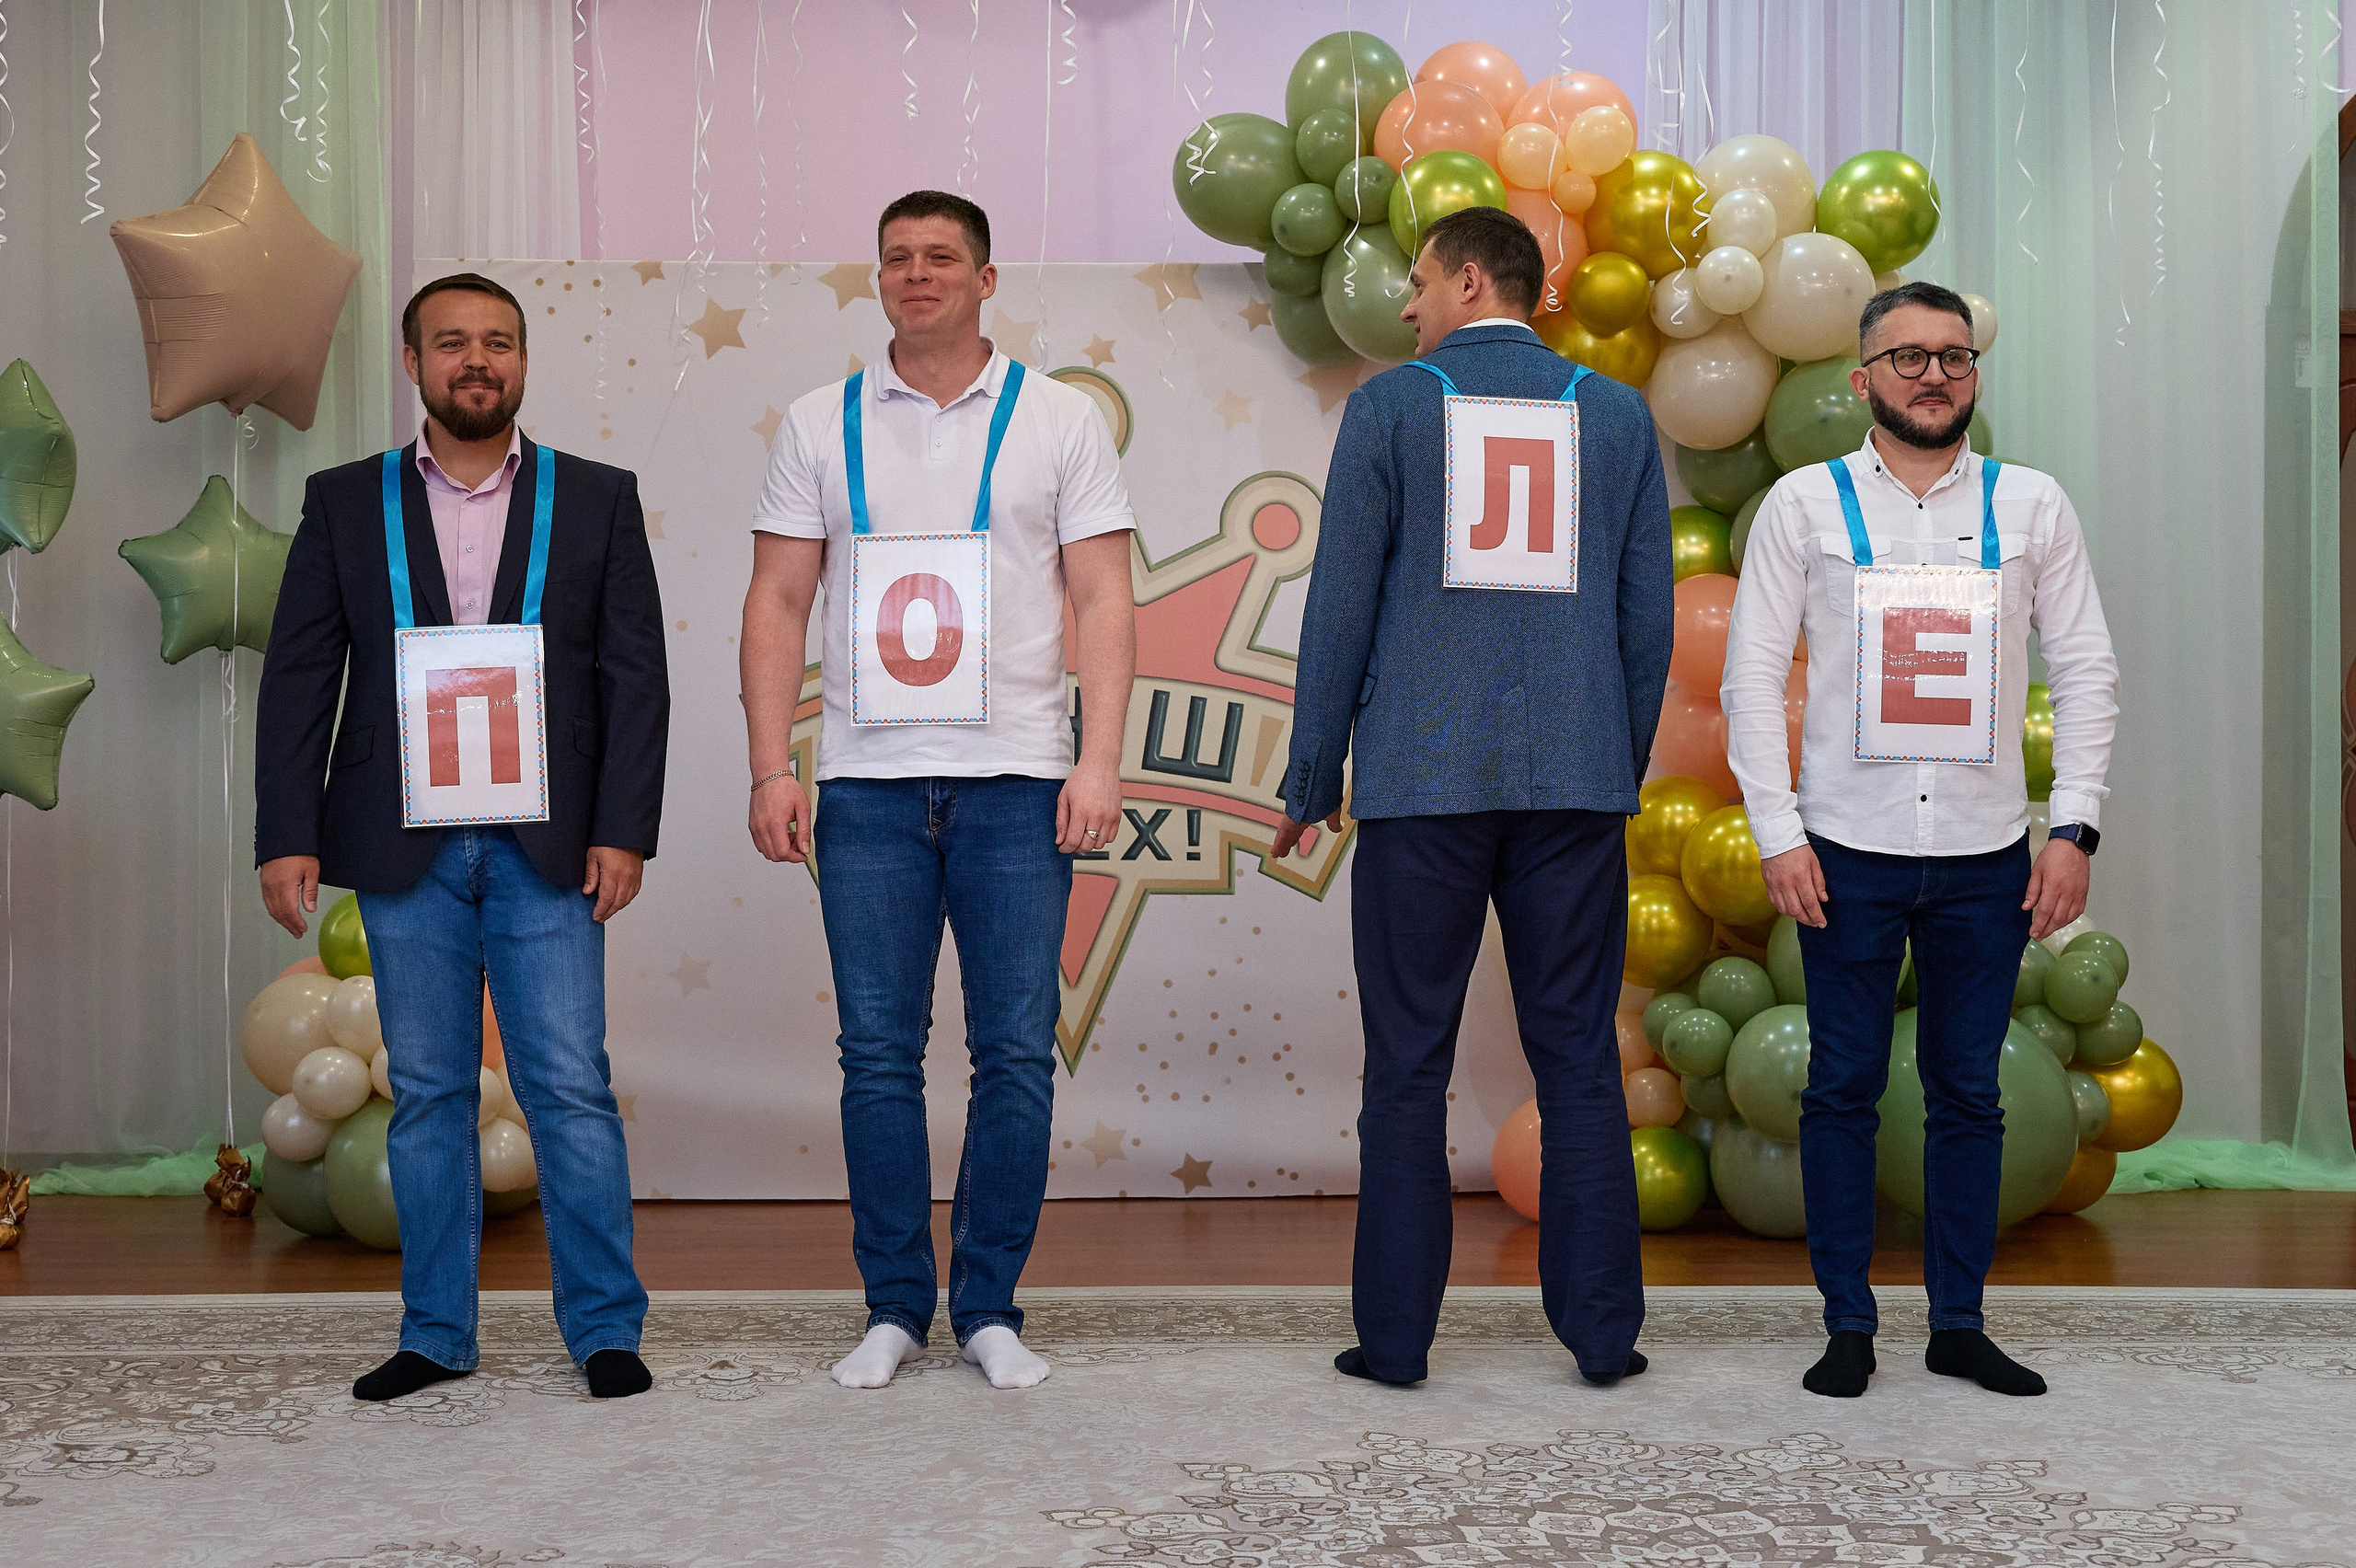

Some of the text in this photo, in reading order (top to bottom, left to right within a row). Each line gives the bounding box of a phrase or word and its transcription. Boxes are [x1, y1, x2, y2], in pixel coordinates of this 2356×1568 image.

[1470, 436, 1555, 553] Л
[876, 573, 964, 686] О
[1880, 607, 1971, 725] Е
[425, 666, 521, 787] П
